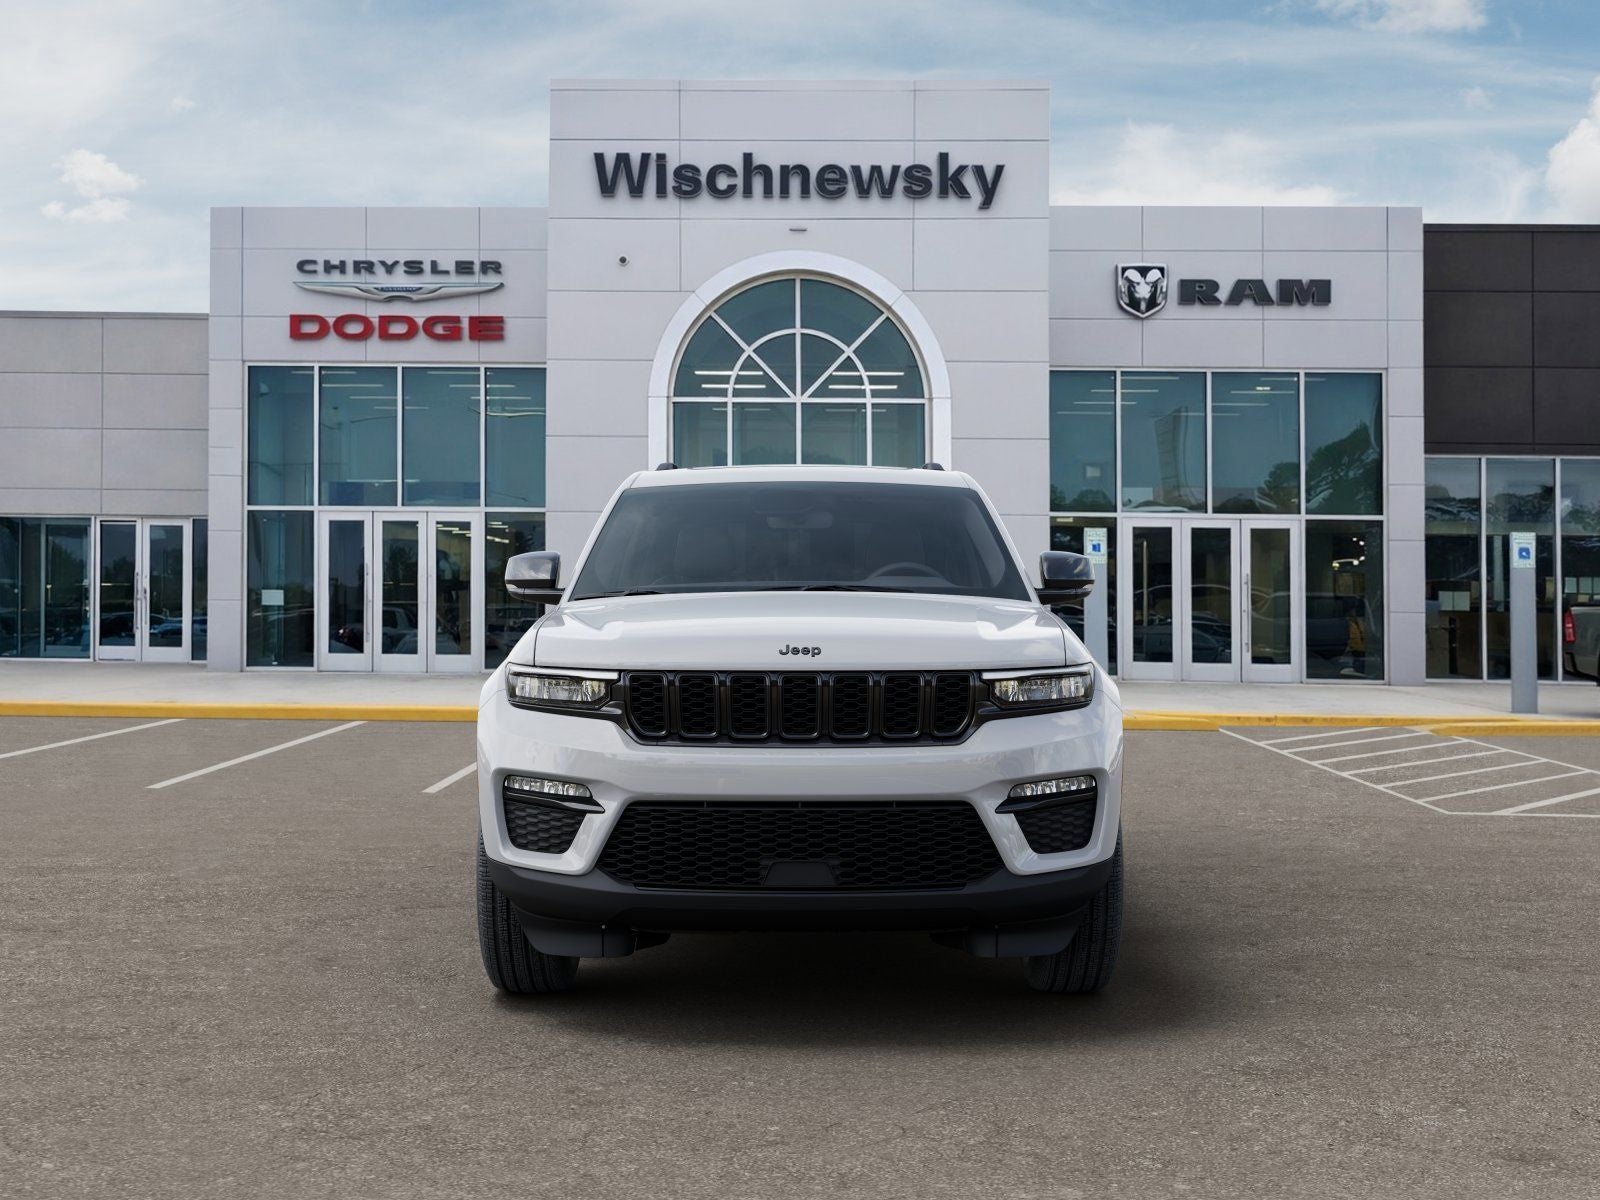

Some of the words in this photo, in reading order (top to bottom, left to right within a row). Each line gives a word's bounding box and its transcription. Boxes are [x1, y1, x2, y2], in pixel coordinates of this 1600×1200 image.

[594, 152, 1005, 210] Wischnewsky
[296, 259, 503, 275] CHRYSLER
[1177, 279, 1332, 306] RAM
[289, 314, 505, 342] DODGE
[779, 644, 822, 658] Jeep
